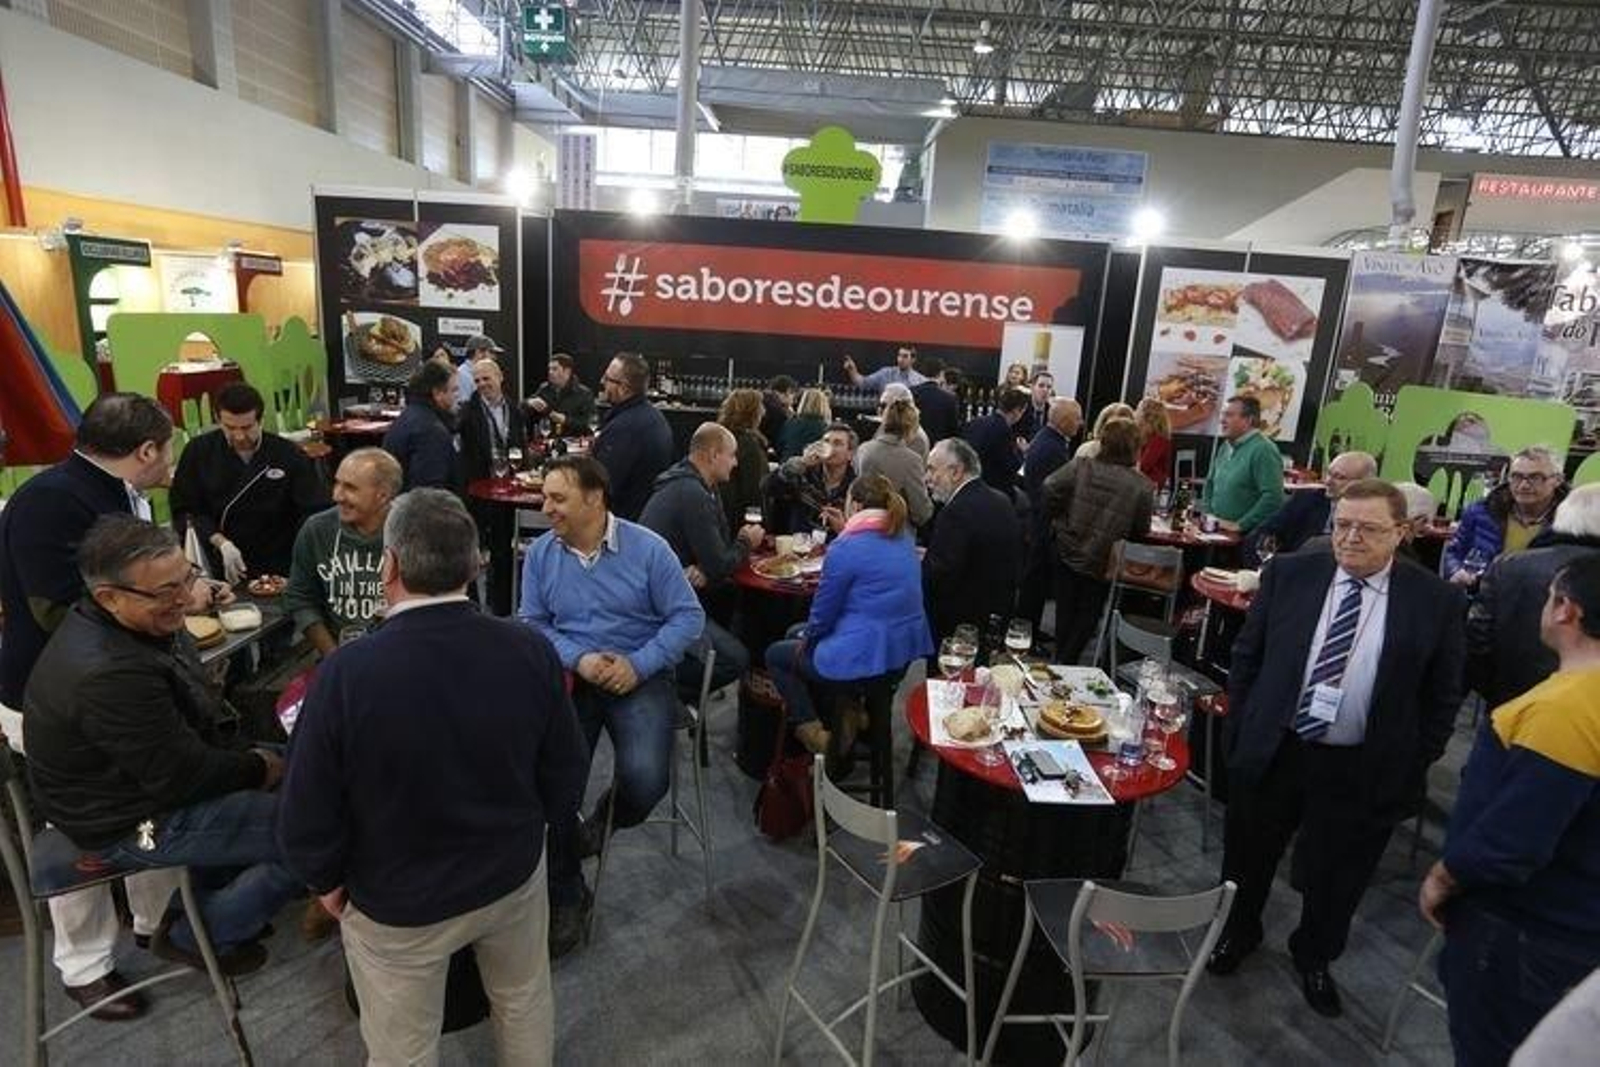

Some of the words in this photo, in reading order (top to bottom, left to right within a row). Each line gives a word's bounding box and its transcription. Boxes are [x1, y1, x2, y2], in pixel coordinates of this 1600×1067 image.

[1479, 180, 1598, 199] RESTAURANTE
[1550, 284, 1598, 311] Tab
[1562, 319, 1588, 339] do
[339, 581, 355, 596] IN
[358, 581, 386, 596] THE
